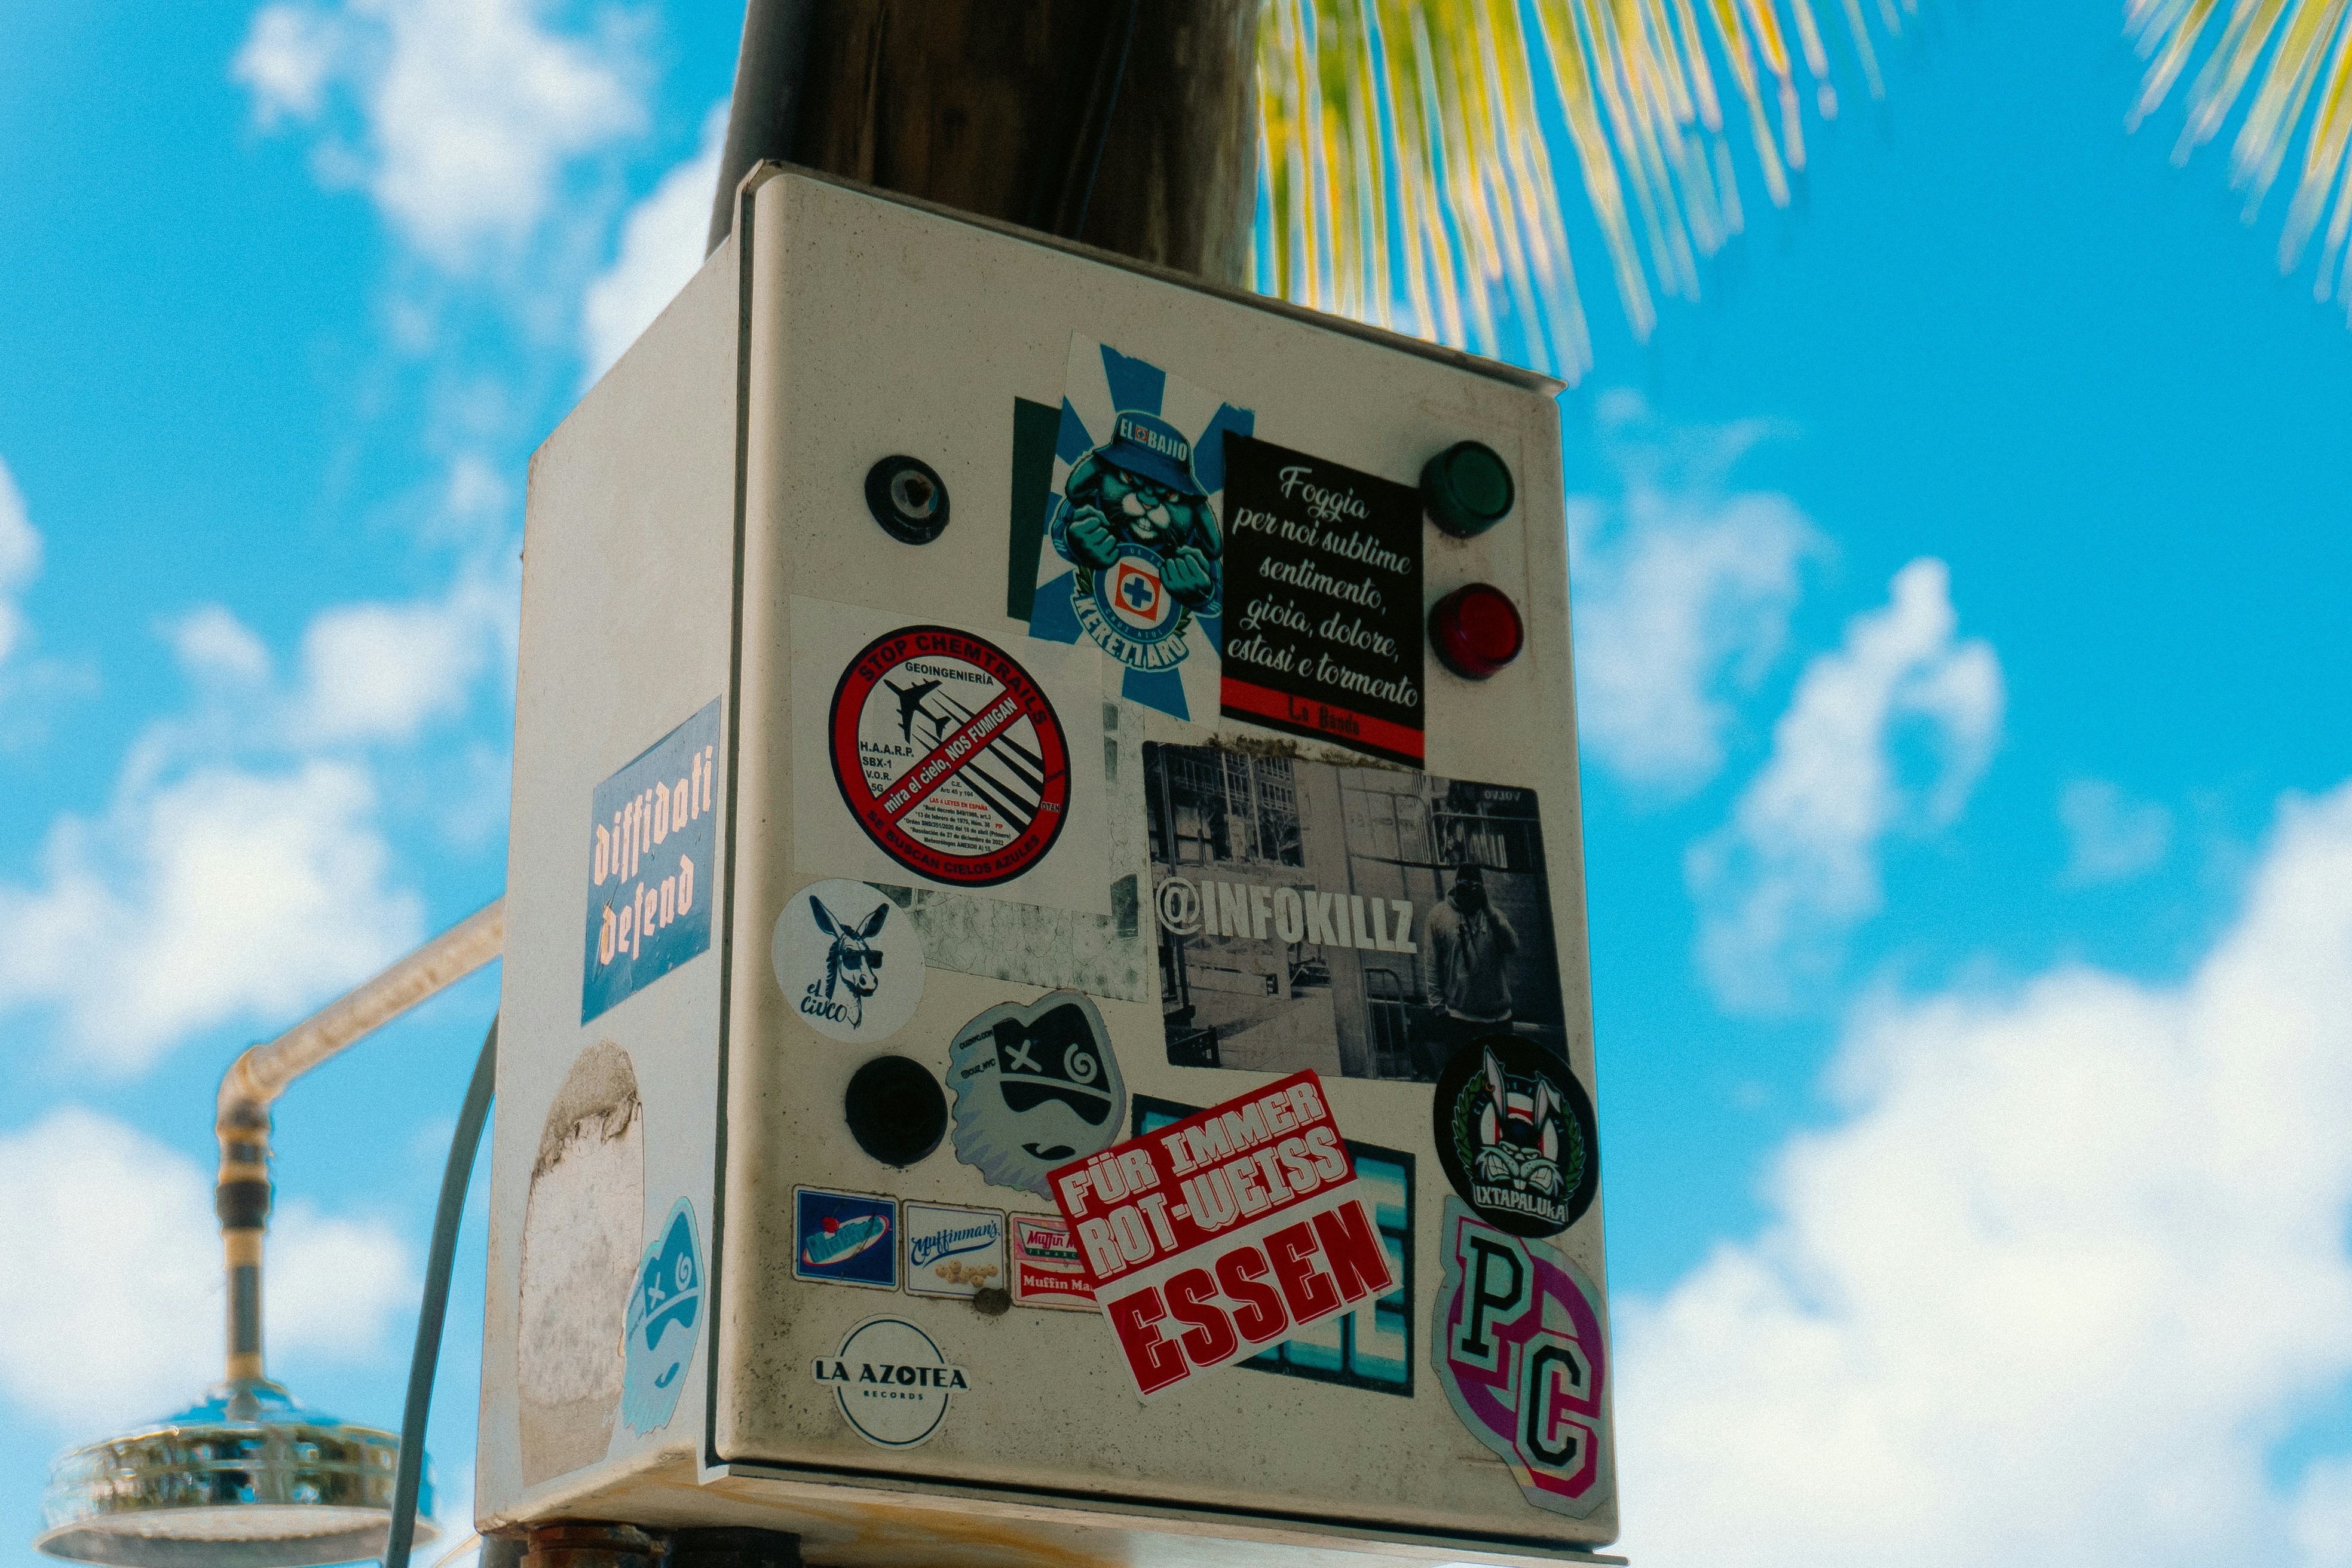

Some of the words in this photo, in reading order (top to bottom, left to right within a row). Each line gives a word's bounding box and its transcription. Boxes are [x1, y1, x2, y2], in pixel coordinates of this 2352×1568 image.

[1120, 418, 1133, 440] EL
[1147, 430, 1187, 461] BAJIO
[1279, 466, 1370, 522] Foggia
[1232, 507, 1278, 535] per
[1281, 520, 1319, 546] noi
[1322, 531, 1411, 574] sublime
[1074, 598, 1187, 668] KERETTARO
[1105, 608, 1129, 632] CRUZ
[1137, 629, 1162, 638] AZUL
[1239, 592, 1313, 638] gioia,
[1319, 611, 1399, 663] dolore,
[859, 639, 907, 681] STOP
[915, 635, 1048, 725] CHEMTRAILS
[905, 662, 994, 686] GEOINGENIERÍA
[1227, 633, 1295, 672] estasi
[1298, 659, 1314, 677] e
[1316, 653, 1418, 707] tormento
[860, 742, 914, 757] H.A.A.R.P.
[862, 756, 892, 768] SBX-1
[884, 789, 911, 814] mira
[908, 776, 922, 794] el
[920, 758, 951, 784] cielo,
[944, 735, 972, 761] NOS
[970, 697, 1018, 743] FUMIGAN
[866, 770, 892, 780] V.O.R.
[871, 783, 884, 792] 5G
[1040, 801, 1061, 813] OTAN
[867, 810, 884, 829] SE
[885, 829, 941, 869] BUSCAN
[944, 862, 992, 875] CIELOS
[996, 834, 1040, 870] AZULES
[599, 854, 694, 966] defend
[1156, 876, 1417, 954] @INFOKILLZ
[807, 979, 823, 997] el
[1059, 1148, 1160, 1218] FÜR
[1161, 1082, 1327, 1176] IMMER
[1077, 1126, 1348, 1279] ROT-WEISS
[911, 1220, 999, 1266] Muffinman's
[1027, 1230, 1066, 1250] Muffin
[1023, 1275, 1068, 1290] Muffin
[1071, 1279, 1094, 1292] Ma
[1107, 1199, 1392, 1395] ESSEN
[815, 1360, 850, 1381] LA
[859, 1363, 967, 1389] AZOTEA
[863, 1391, 924, 1401] RECORDS
